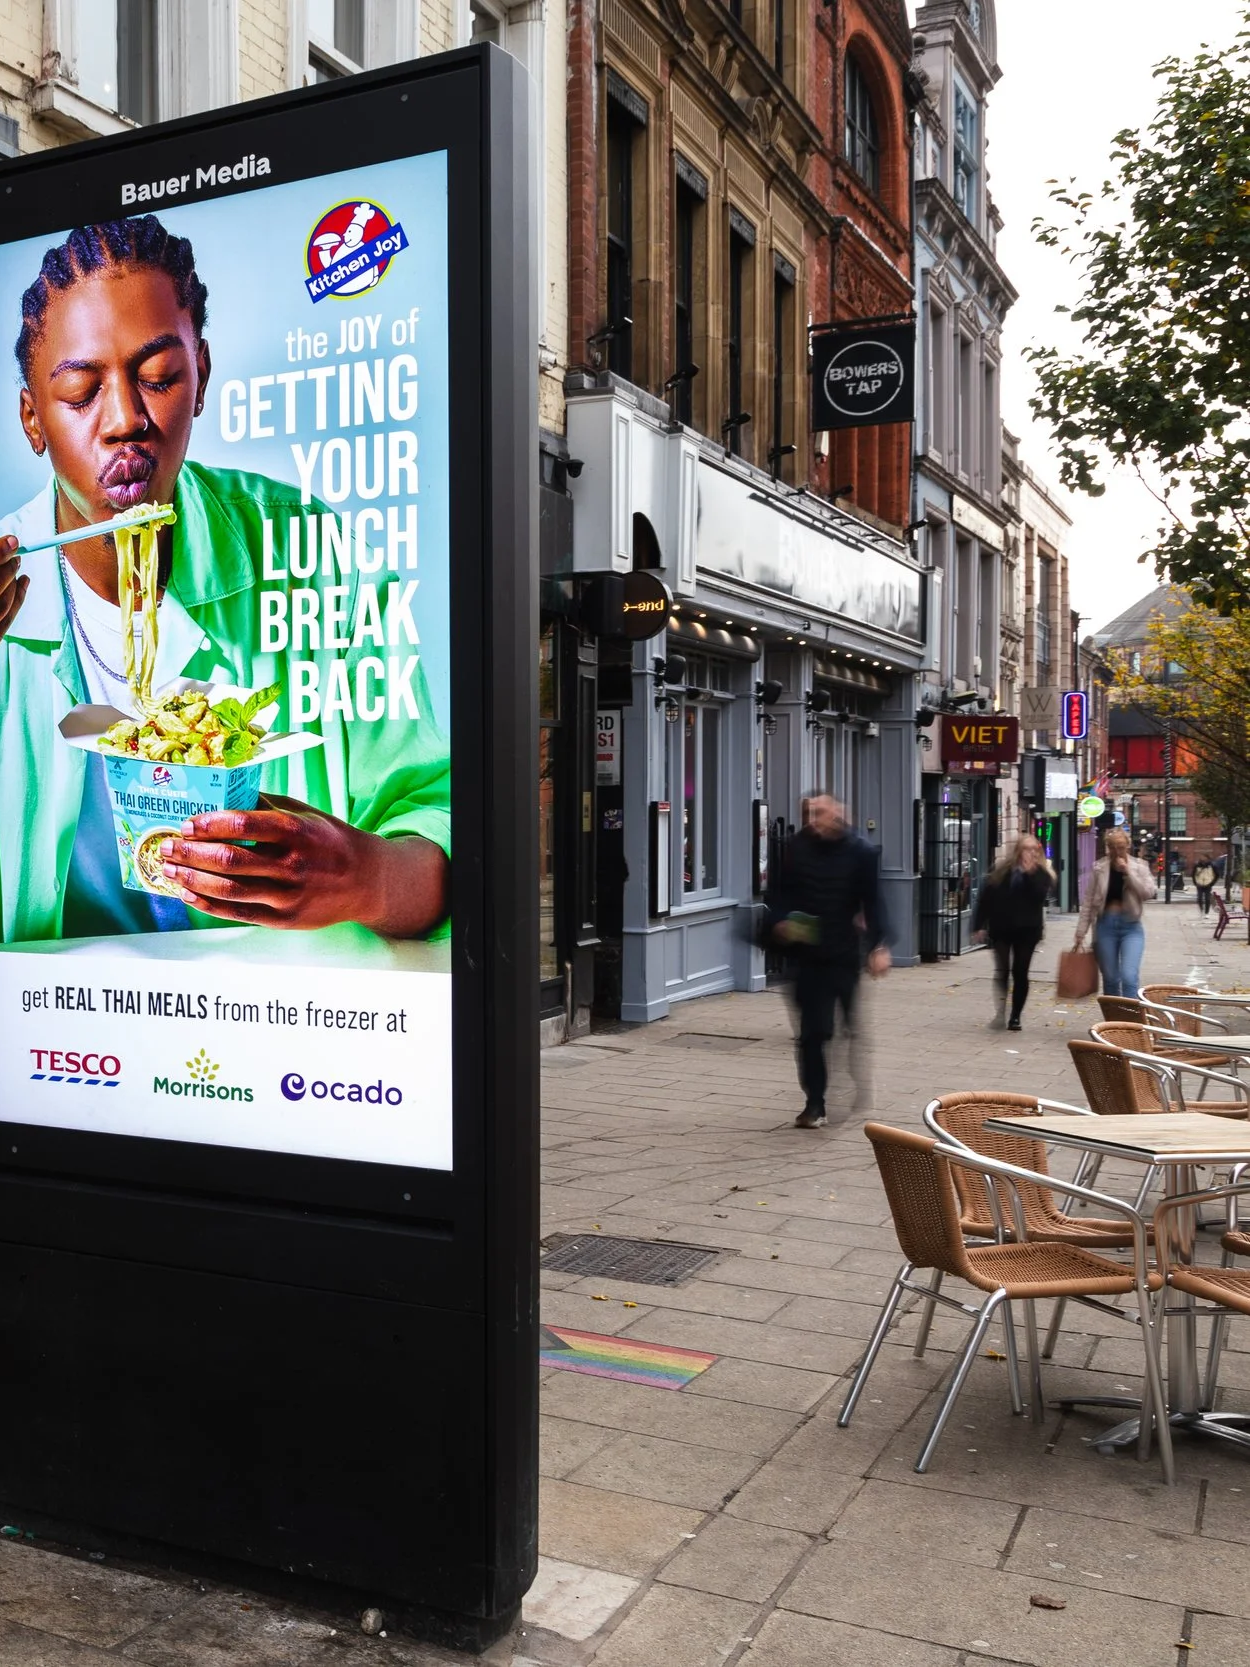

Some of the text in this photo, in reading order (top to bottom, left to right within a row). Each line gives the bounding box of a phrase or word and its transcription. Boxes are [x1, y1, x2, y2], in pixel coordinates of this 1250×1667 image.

[121, 154, 271, 206] Bauer Media
[308, 231, 402, 297] Kitchen Joy
[285, 307, 419, 362] the JOY of
[829, 361, 899, 381] BOWERS
[845, 380, 882, 396] TAP
[220, 354, 418, 443] GETTING
[290, 430, 419, 505] YOUR
[262, 504, 418, 581] LUNCH
[260, 580, 420, 653] BREAK
[291, 654, 421, 724] BACK
[952, 725, 1008, 744] VIET
[1071, 695, 1081, 736] VAPES
[114, 790, 218, 816] THAI GREEN CHICKEN
[22, 986, 407, 1033] get REAL THAI MEALS from the freezer at
[30, 1049, 122, 1076] TESCO
[153, 1076, 254, 1102] Morrisons
[311, 1080, 403, 1106] ocado
